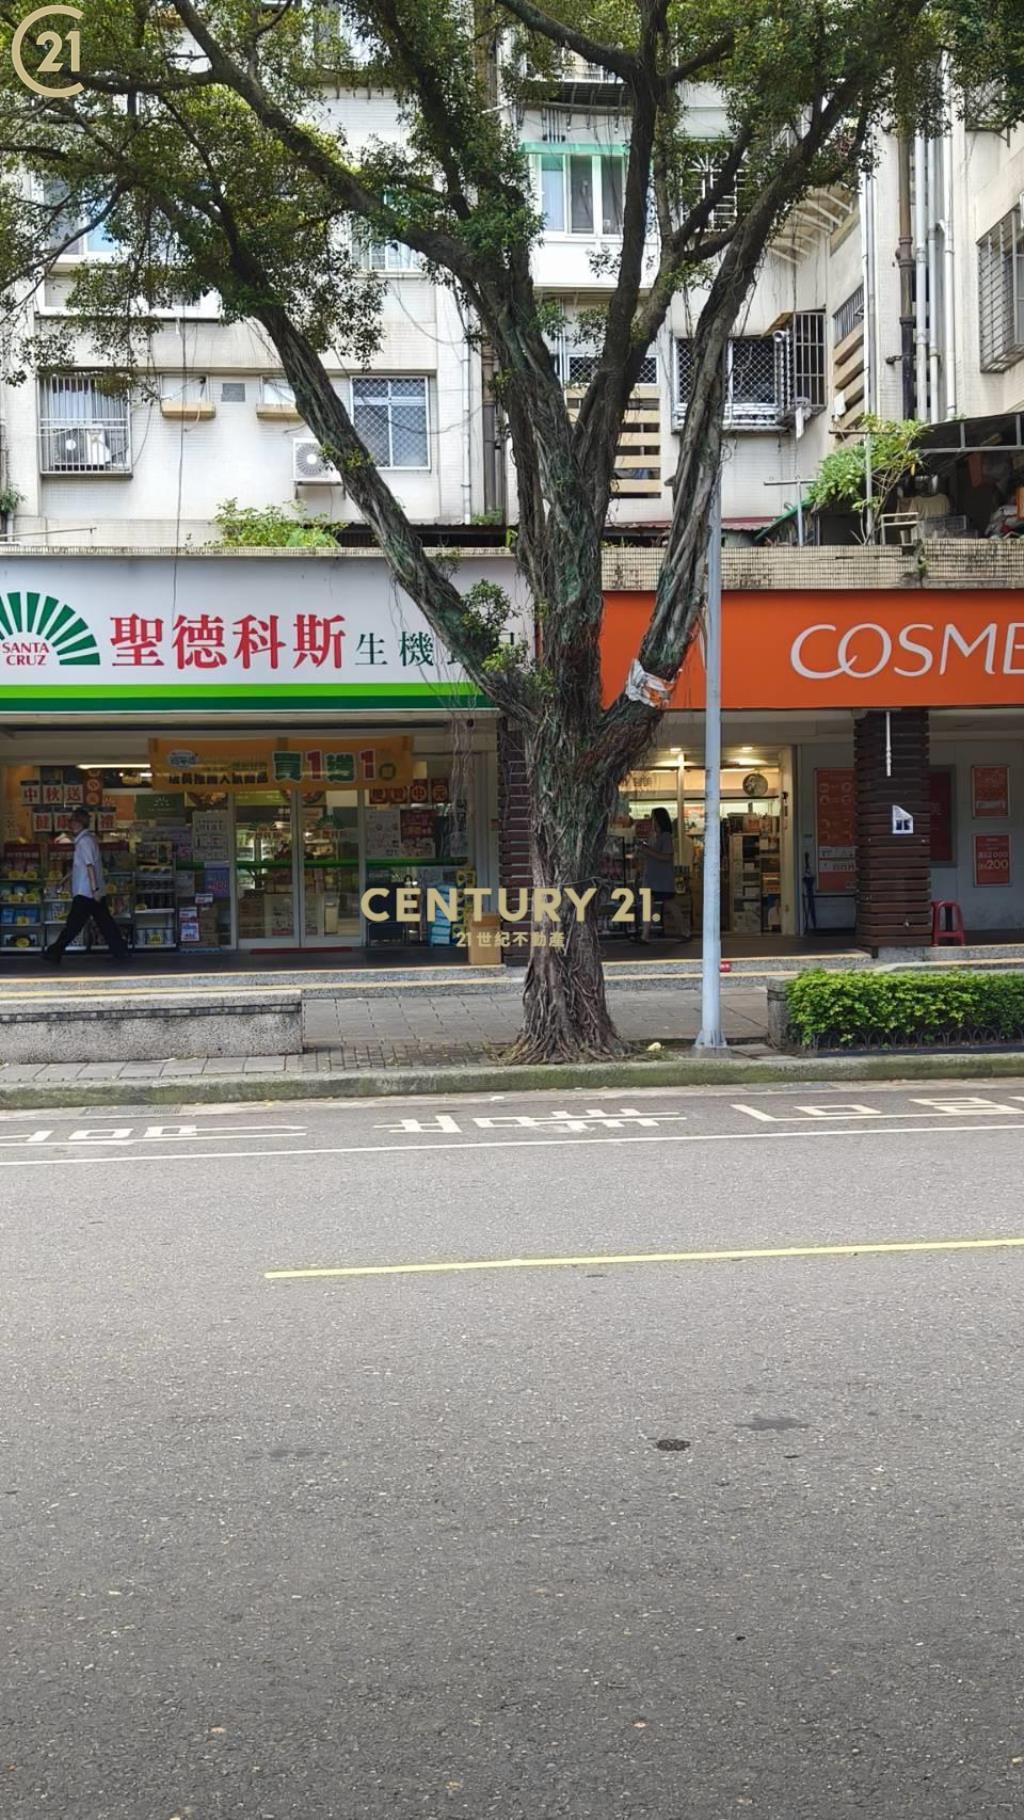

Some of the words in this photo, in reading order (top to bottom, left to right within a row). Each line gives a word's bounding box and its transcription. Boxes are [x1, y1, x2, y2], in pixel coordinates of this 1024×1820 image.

[2, 641, 50, 654] SANTA
[109, 613, 347, 670] 聖德科斯
[6, 654, 47, 667] CRUZ
